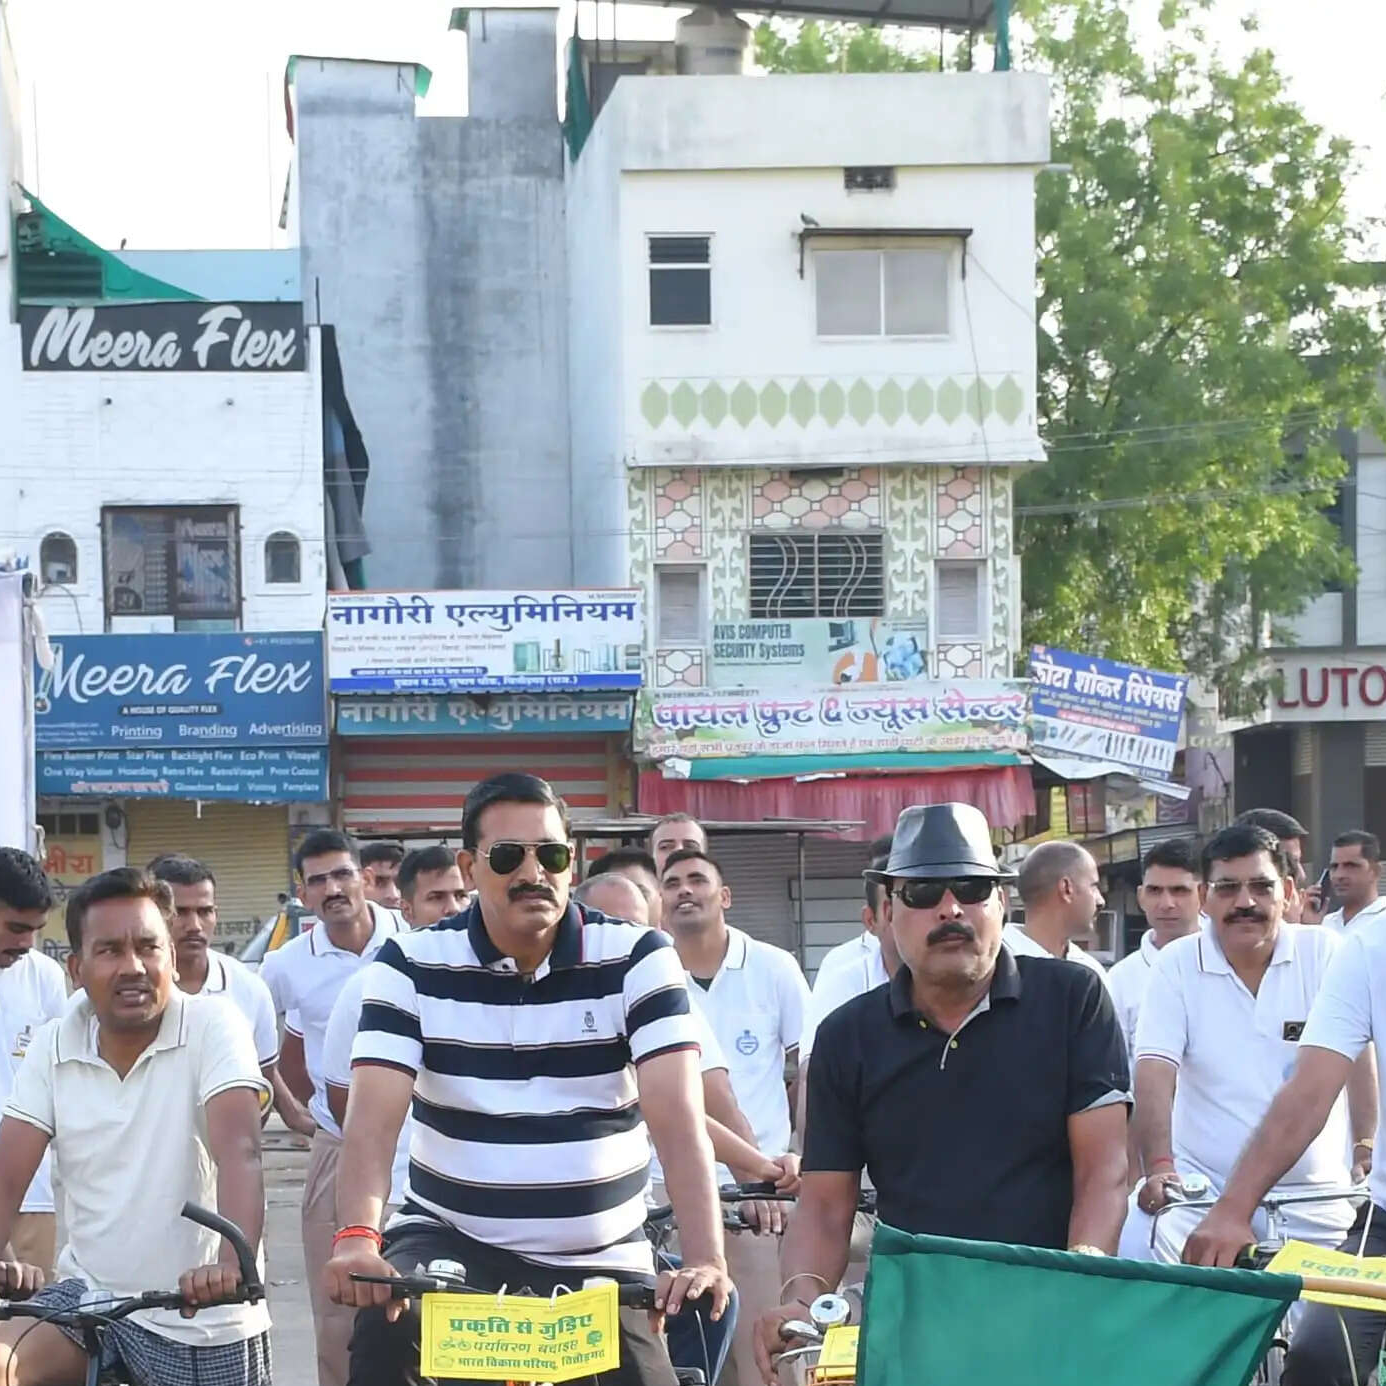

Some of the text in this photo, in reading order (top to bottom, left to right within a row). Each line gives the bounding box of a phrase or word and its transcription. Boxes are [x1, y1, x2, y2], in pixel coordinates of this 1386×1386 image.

[30, 305, 296, 367] Meera Flex
[330, 595, 636, 632] नागौरी एल्युमिनियम
[714, 624, 791, 639] AVIS COMPUTER
[759, 642, 805, 660] Systems
[41, 645, 312, 703] Meera Flex
[340, 695, 437, 723] नागौरी
[655, 703, 748, 727] पायल
[111, 725, 163, 739] Printing
[179, 723, 237, 738] Branding
[249, 722, 322, 737] Advertising
[44, 845, 93, 875] मीरा
[449, 1314, 593, 1341] प्रकृति से जुड़िए
